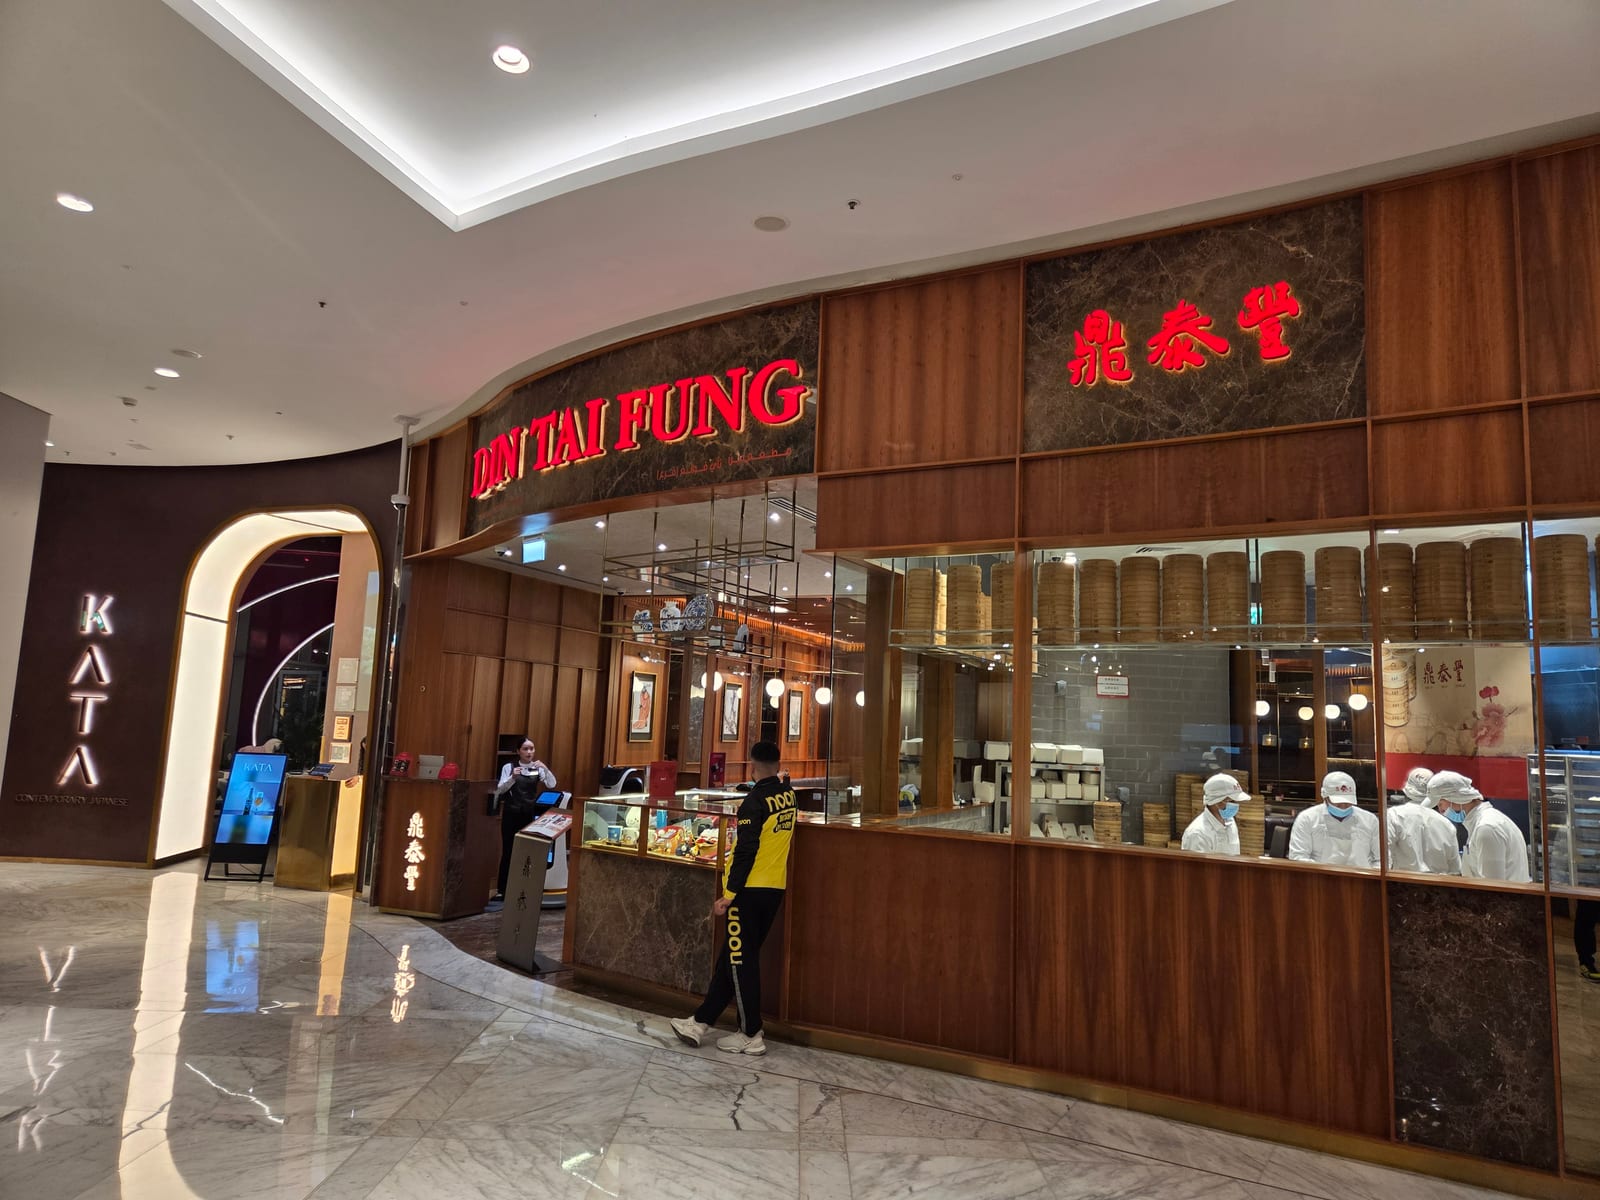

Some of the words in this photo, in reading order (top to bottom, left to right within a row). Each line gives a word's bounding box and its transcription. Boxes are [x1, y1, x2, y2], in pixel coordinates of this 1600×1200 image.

[1067, 281, 1299, 385] 鼎泰豐
[470, 426, 526, 499] DIN
[529, 397, 608, 471] TAI
[614, 359, 810, 451] FUNG
[56, 592, 115, 787] KATA
[244, 761, 272, 772] KATA
[15, 793, 86, 805] CONTEMPORARY
[88, 796, 129, 807] JAPANESE
[765, 790, 796, 813] noon
[727, 906, 743, 965] noon
